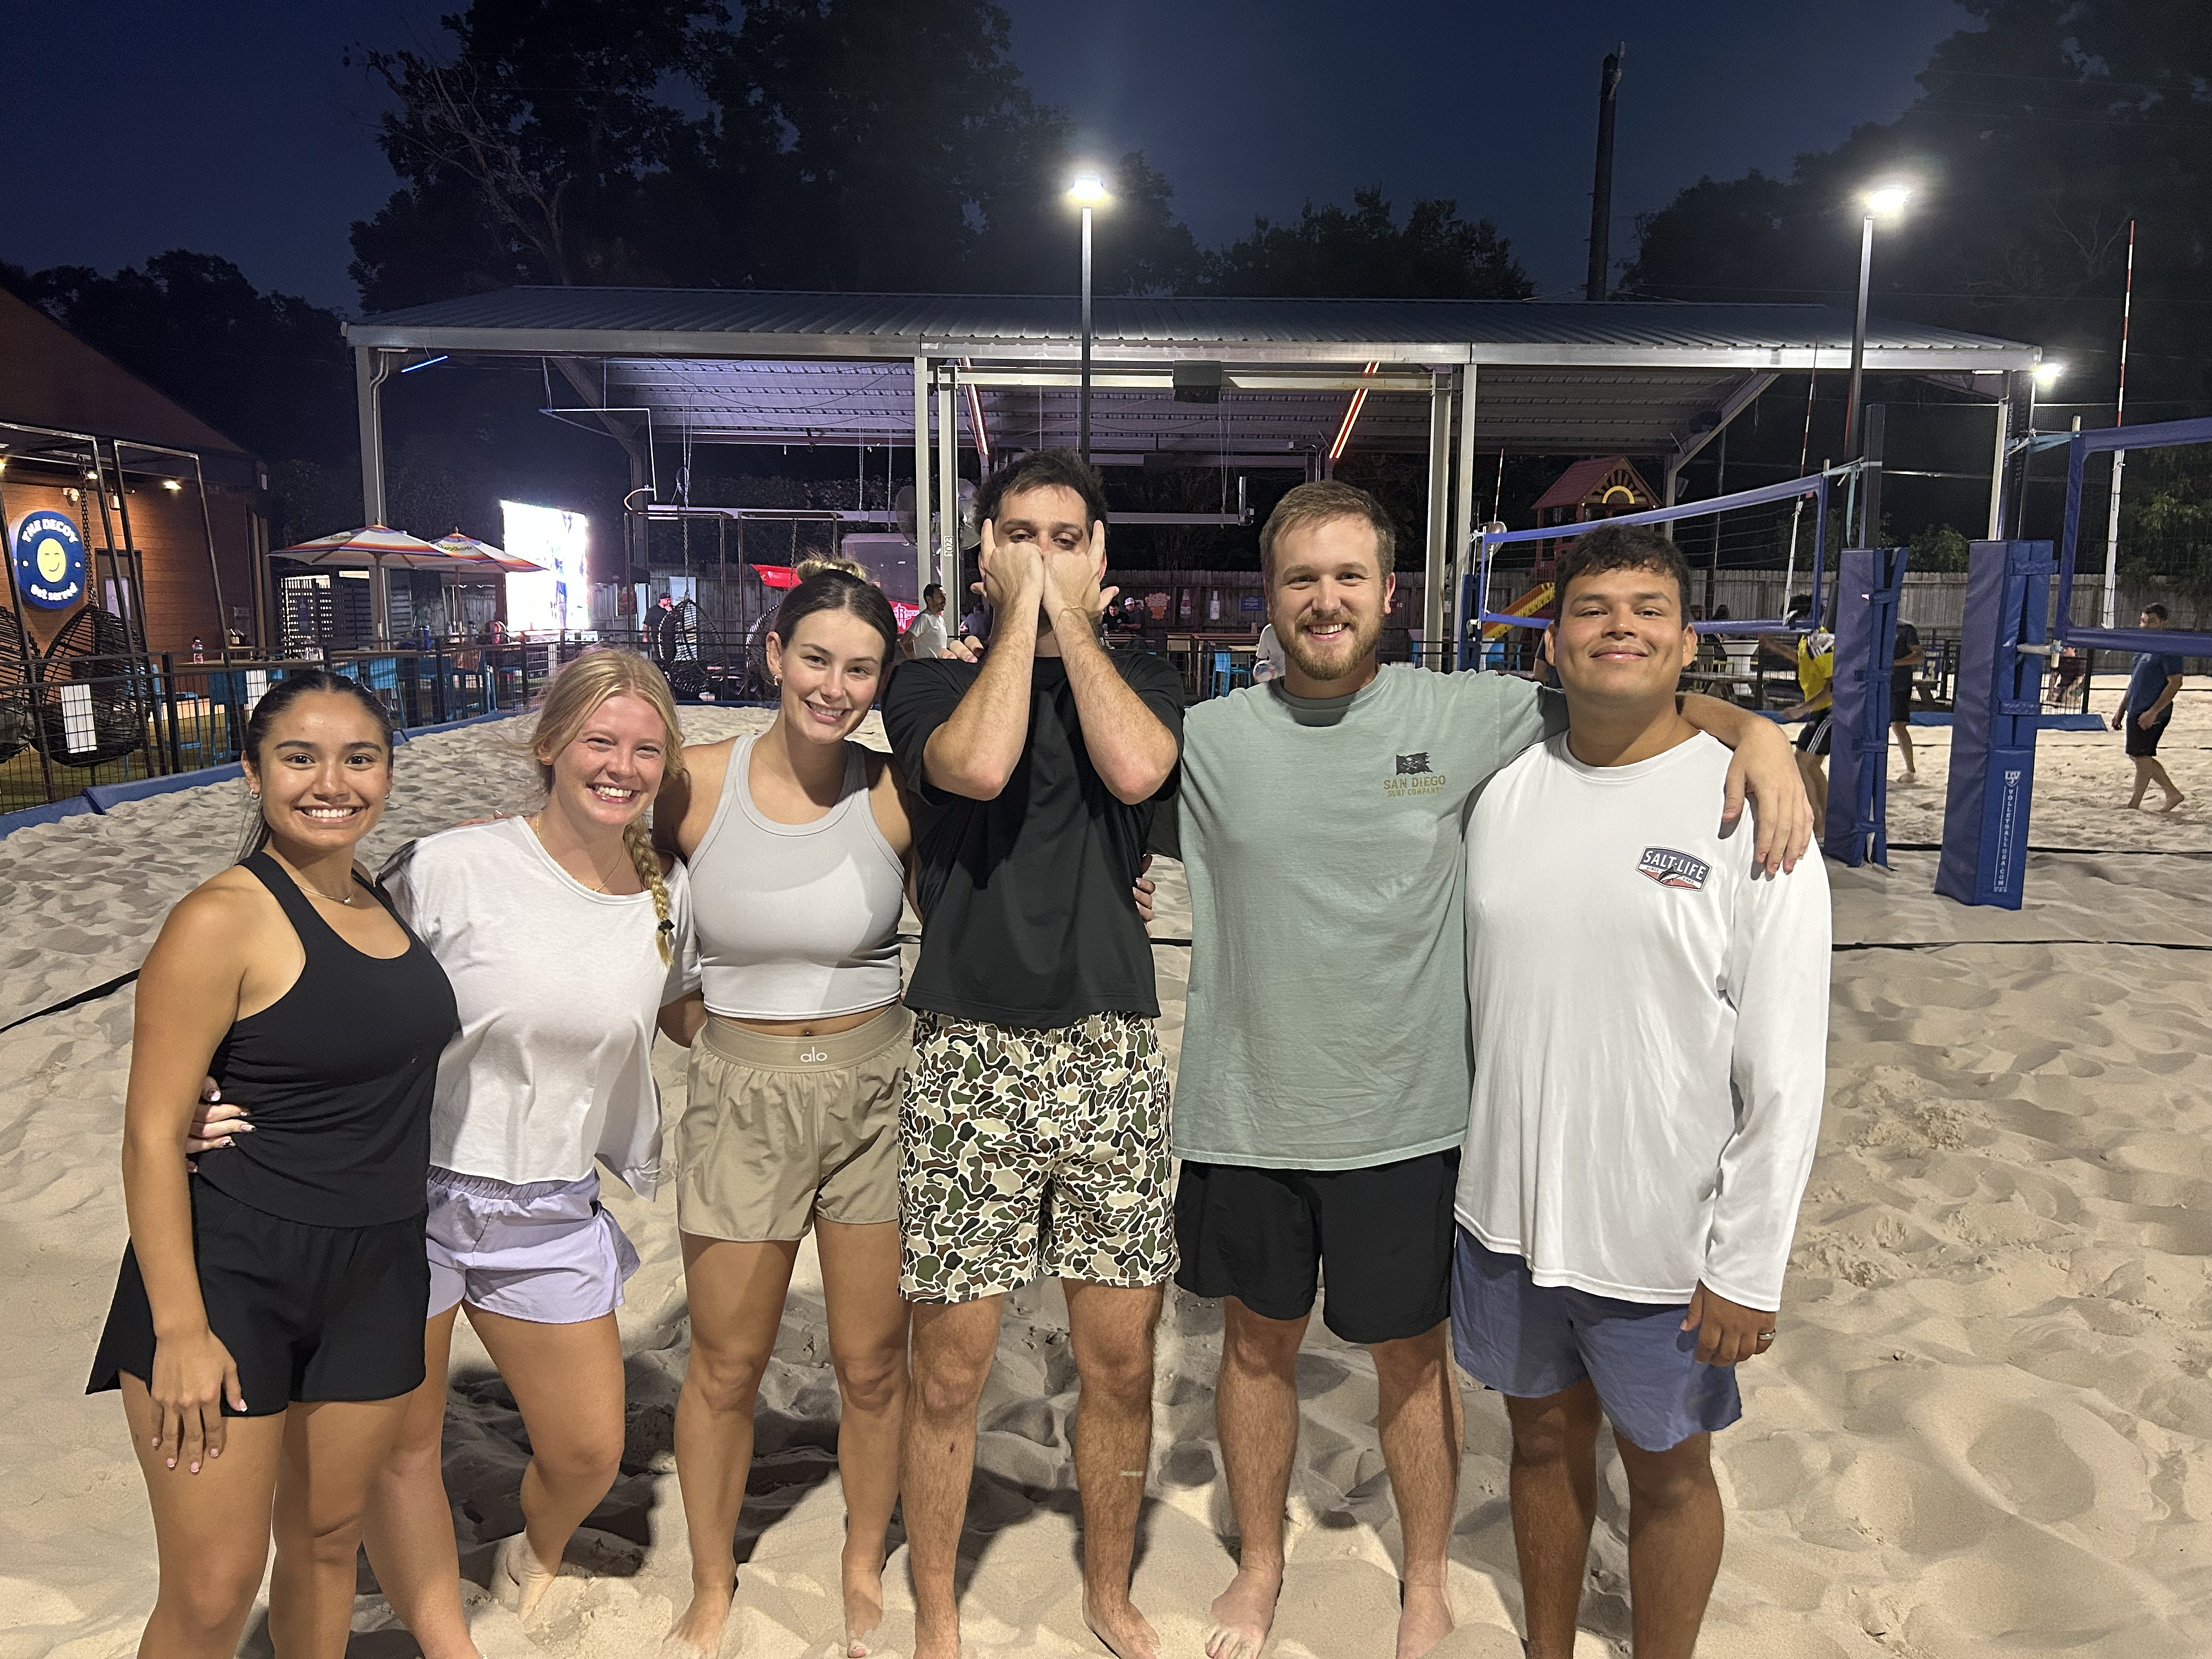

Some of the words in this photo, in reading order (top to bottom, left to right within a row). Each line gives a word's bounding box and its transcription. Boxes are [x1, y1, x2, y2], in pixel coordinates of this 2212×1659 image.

[22, 520, 42, 543] THE
[42, 518, 79, 543] DECOY
[945, 537, 953, 556] 1023
[1925, 660, 1936, 681] 3
[1384, 777, 1407, 789] SAN
[1412, 775, 1446, 787] DIEGO
[1408, 787, 1441, 795] COMPANY
[800, 1046, 827, 1063] alo
